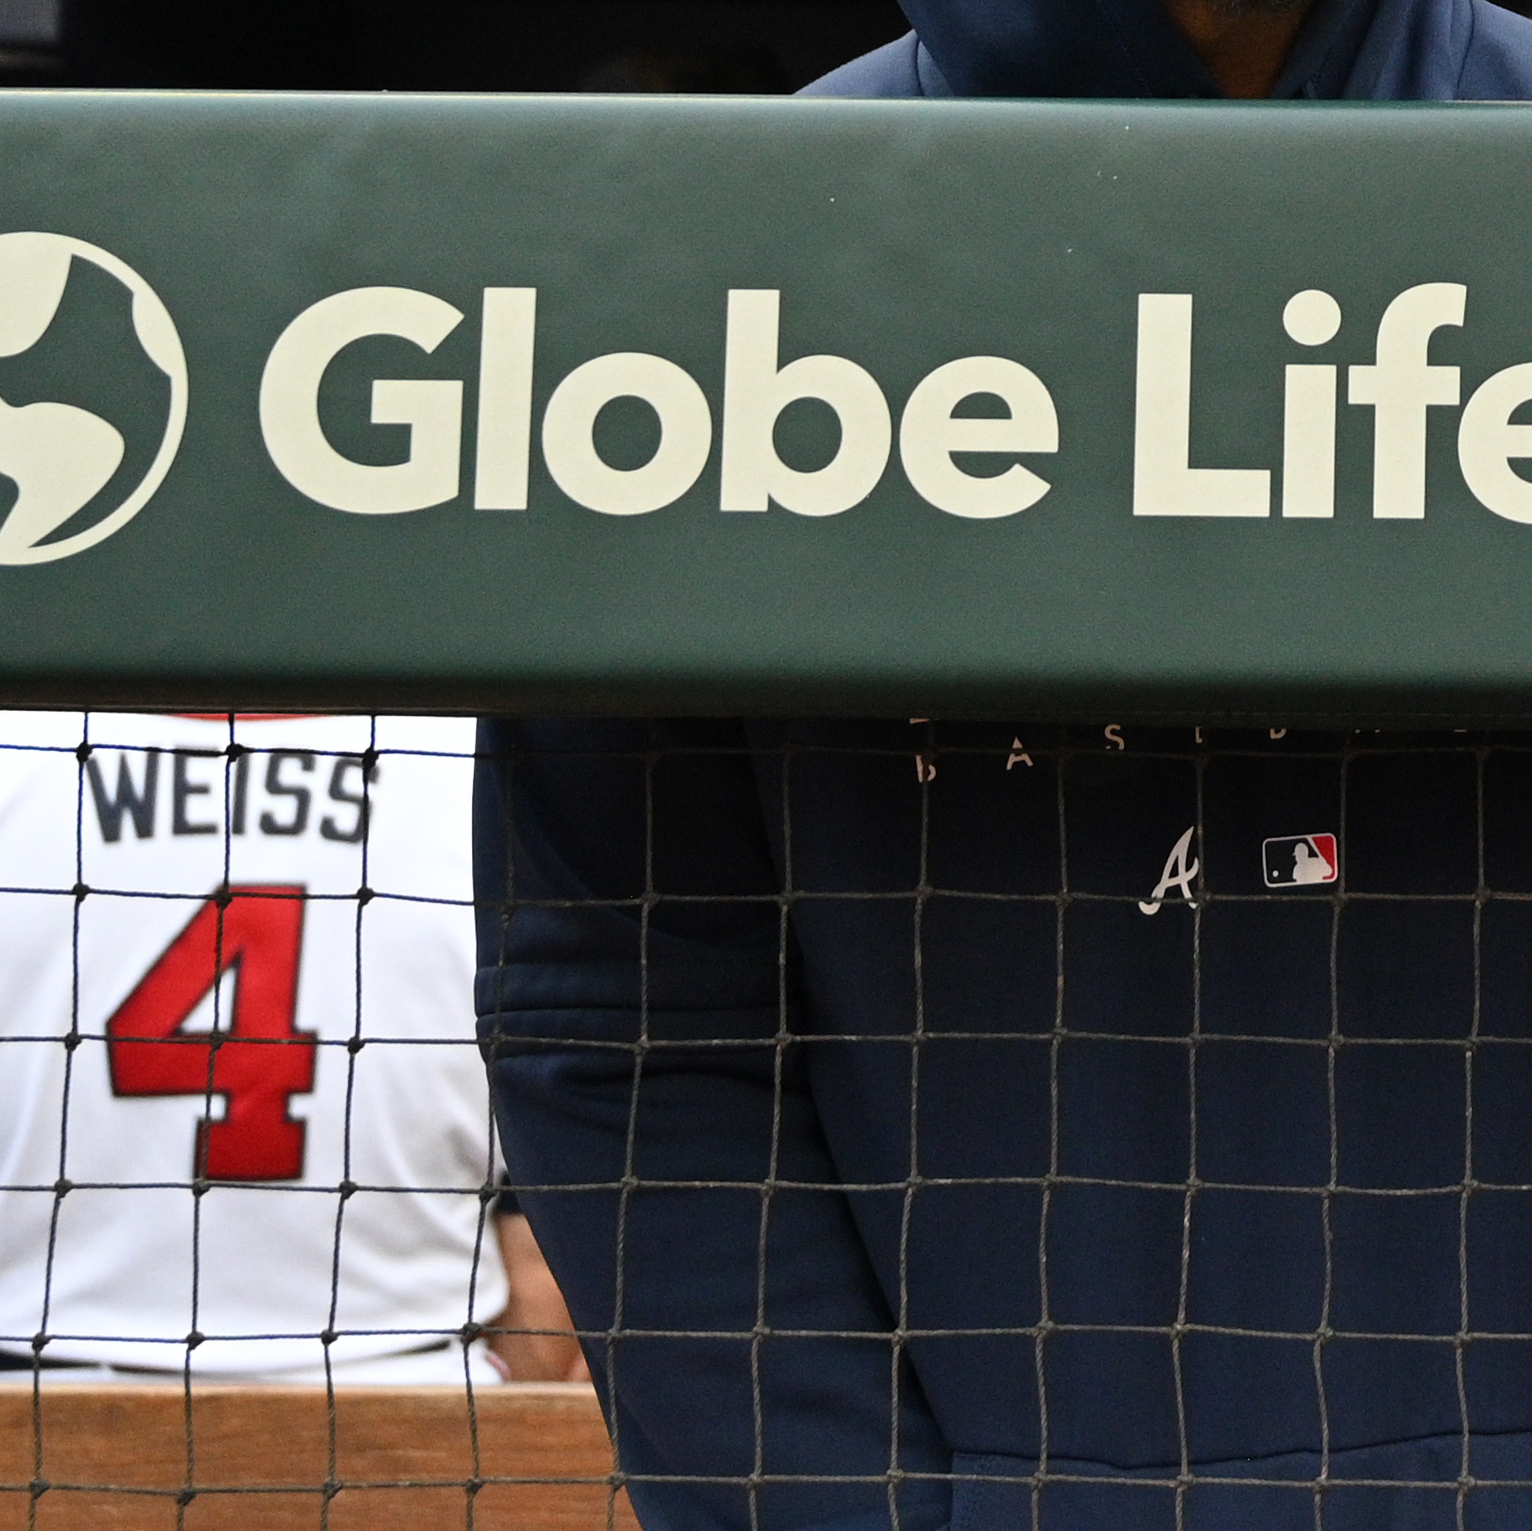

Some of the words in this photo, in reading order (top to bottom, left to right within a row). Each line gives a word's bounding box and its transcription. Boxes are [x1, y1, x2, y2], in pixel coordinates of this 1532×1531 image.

[258, 285, 1060, 520] Globe
[84, 744, 381, 845] WEISS
[105, 880, 319, 1183] 4
